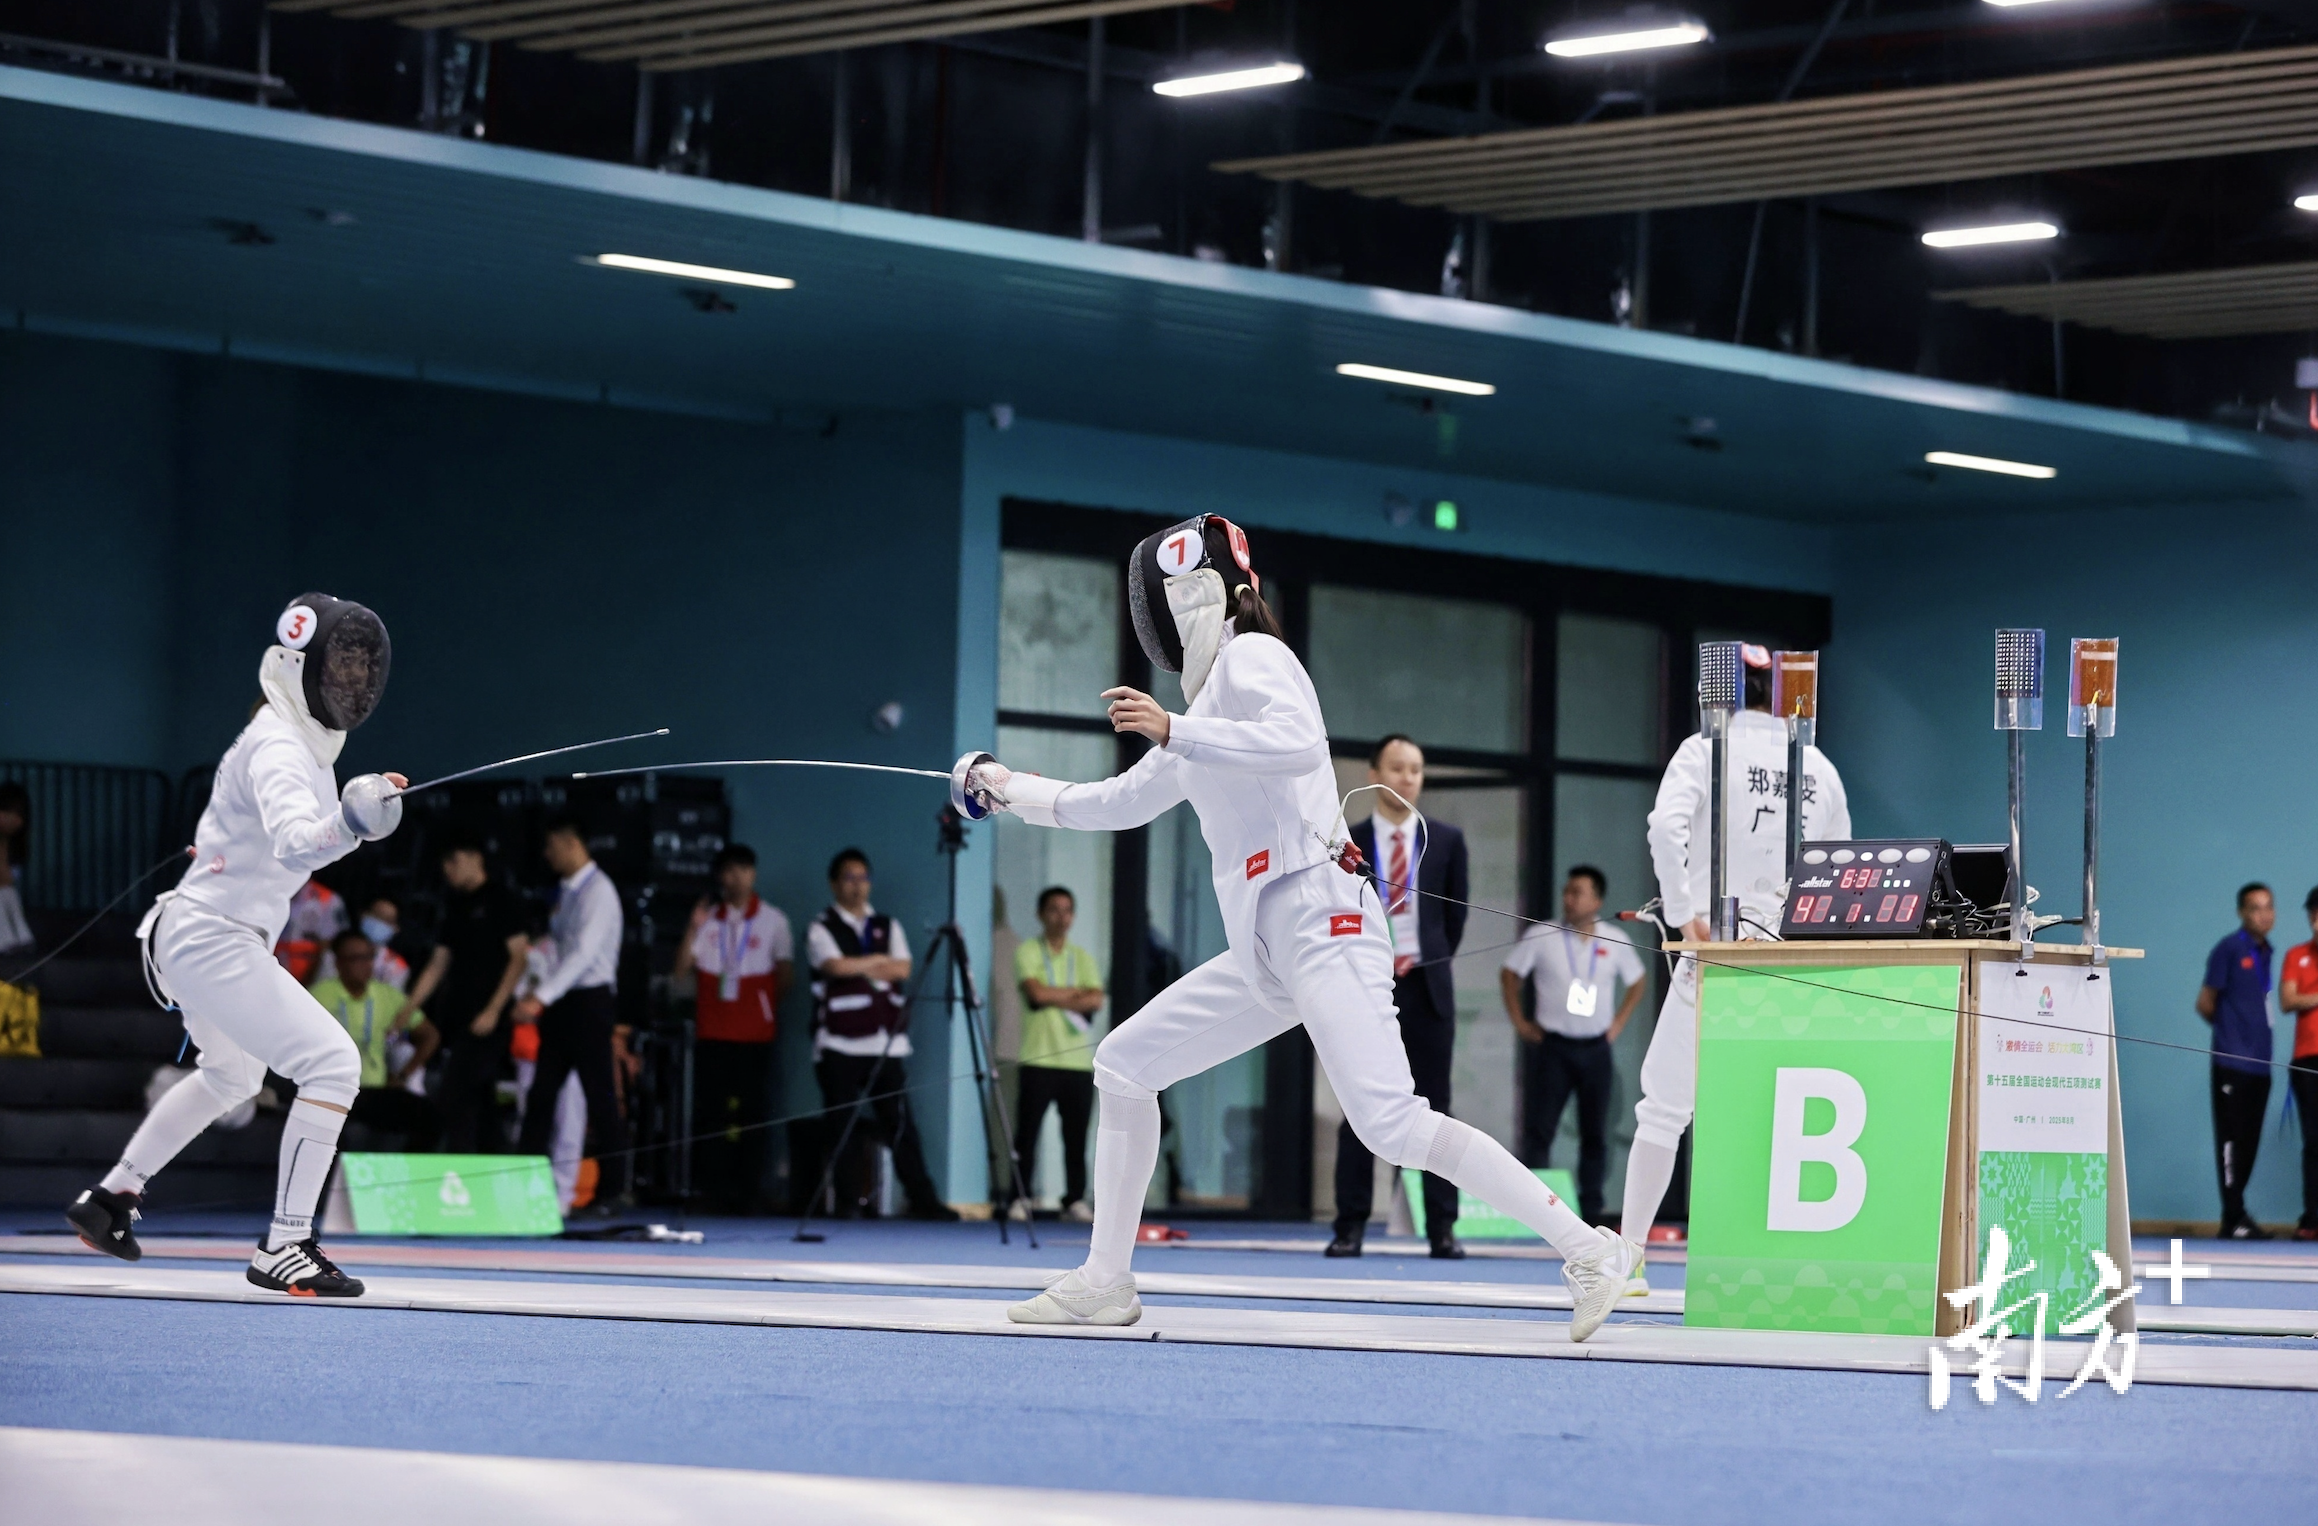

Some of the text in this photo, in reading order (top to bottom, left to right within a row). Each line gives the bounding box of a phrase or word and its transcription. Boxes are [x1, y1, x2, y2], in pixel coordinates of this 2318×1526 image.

[1168, 536, 1186, 567] 7
[288, 614, 307, 640] 3
[1799, 876, 1834, 889] allstar
[2005, 1040, 2084, 1055] 激情全运会 活力大湾区
[1986, 1074, 2102, 1090] 第十五届全国运动会现代五项测试赛
[1767, 1067, 1867, 1232] B
